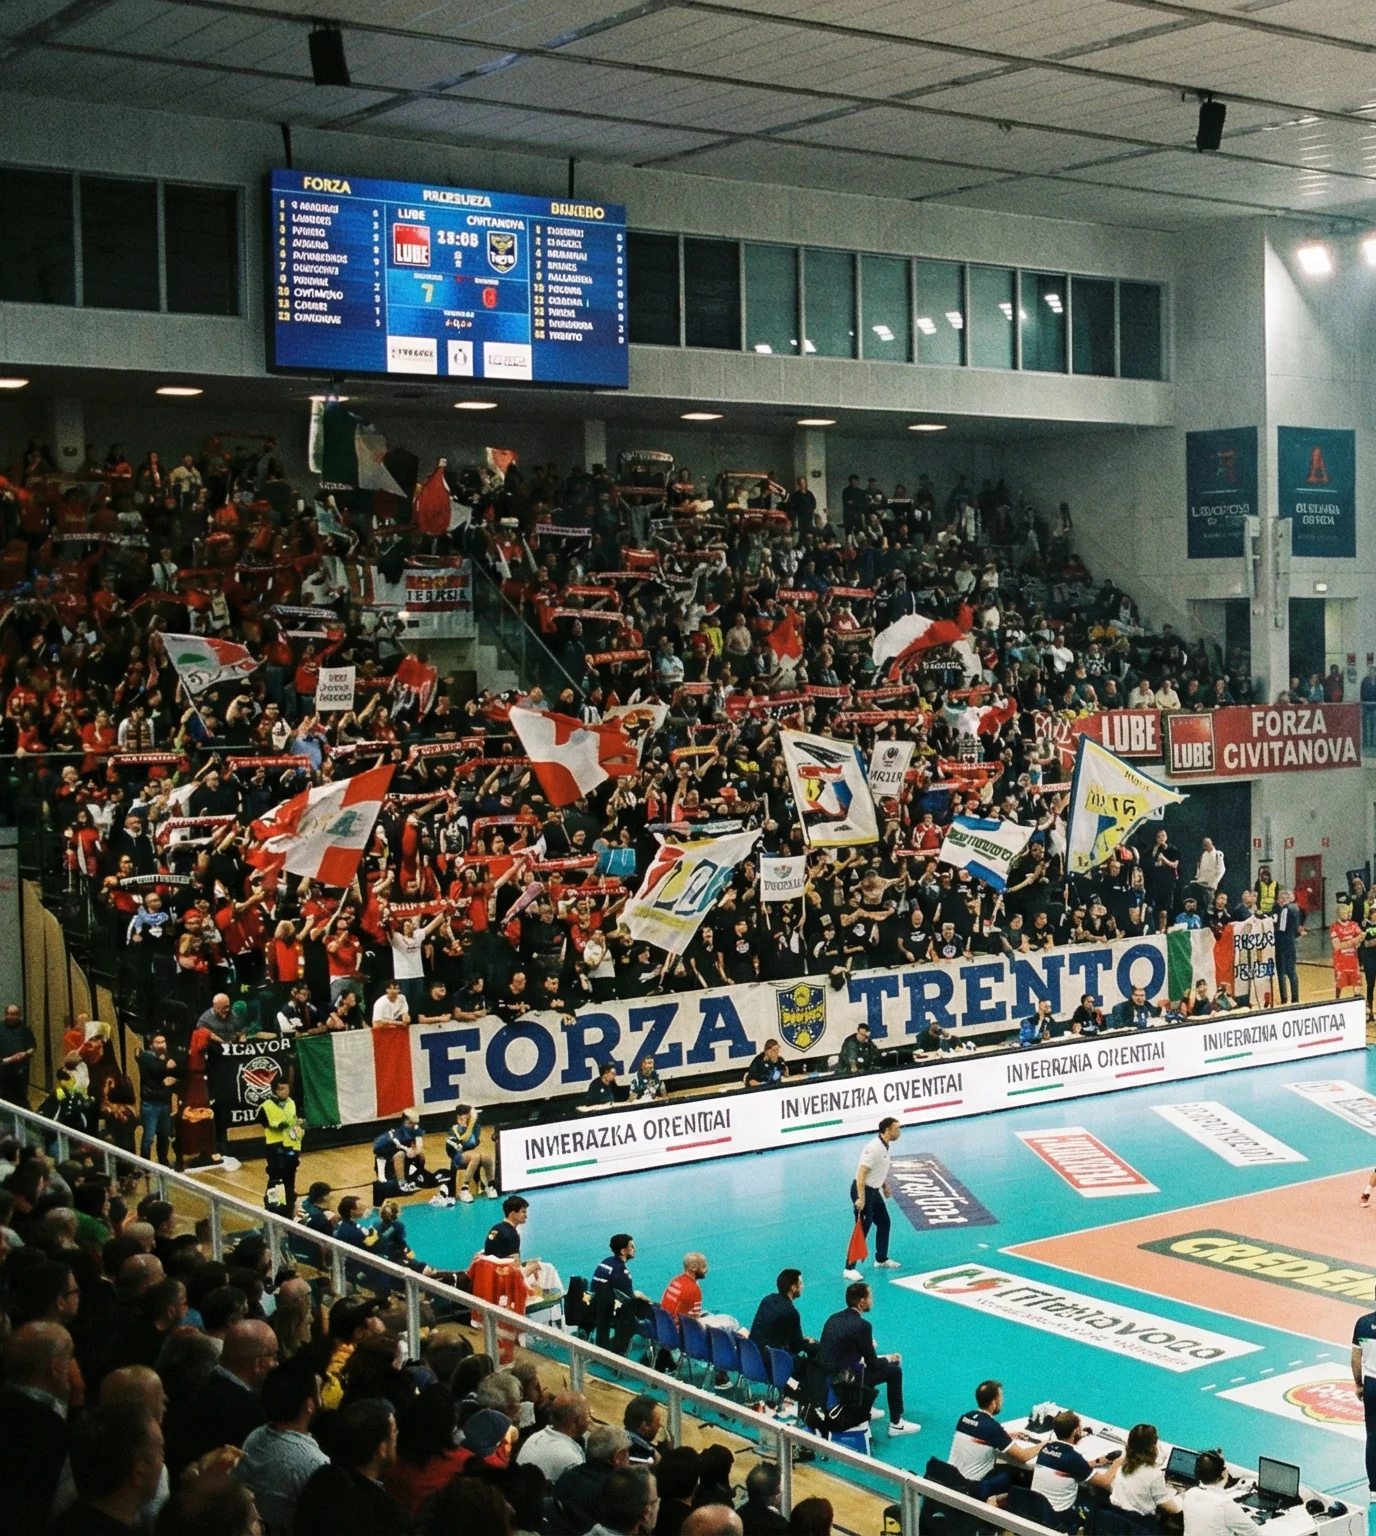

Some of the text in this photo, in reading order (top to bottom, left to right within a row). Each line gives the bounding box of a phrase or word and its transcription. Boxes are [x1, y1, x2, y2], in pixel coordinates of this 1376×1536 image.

[303, 176, 352, 194] FORZA
[398, 209, 425, 220] LUBE
[396, 243, 429, 263] LUBE
[1101, 713, 1157, 752] LUBE
[1252, 709, 1327, 738] FORZA
[1173, 742, 1212, 768] LUBE
[1223, 737, 1358, 770] CIVITANOVA
[421, 996, 757, 1104] FORZA
[848, 943, 1166, 1039] TRENTO
